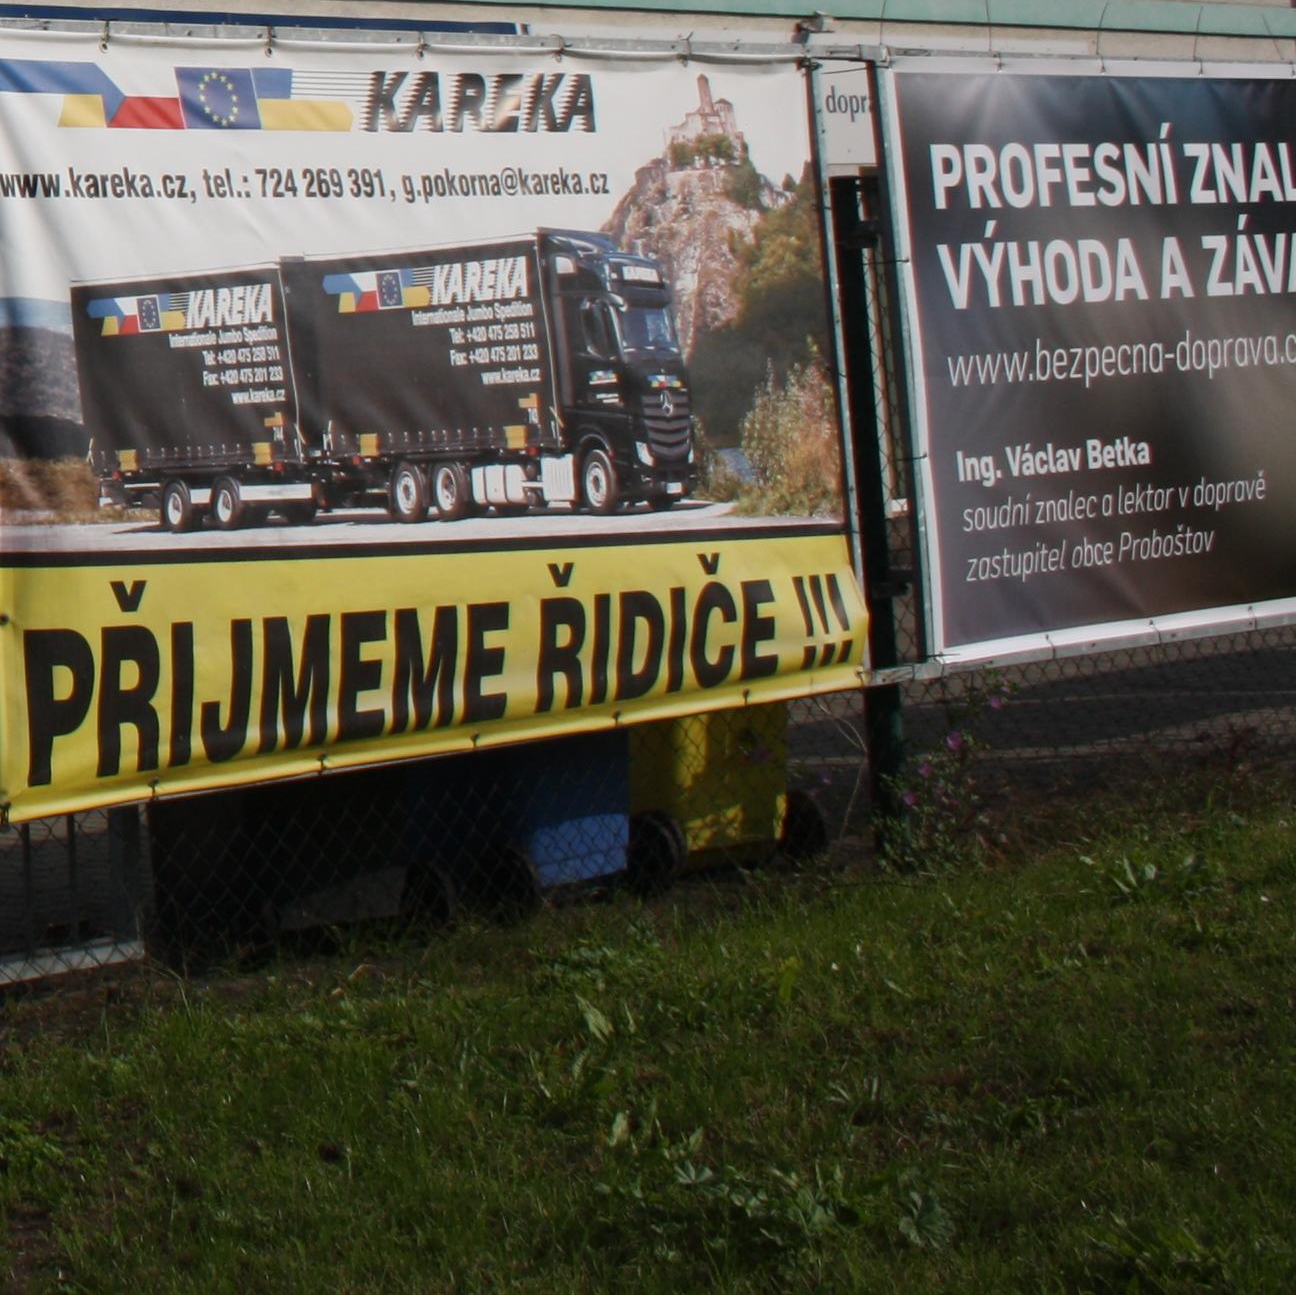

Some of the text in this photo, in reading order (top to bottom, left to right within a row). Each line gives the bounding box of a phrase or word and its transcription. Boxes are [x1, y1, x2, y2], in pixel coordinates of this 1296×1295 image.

[358, 70, 597, 133] KAREKA
[825, 85, 872, 123] dopr
[203, 169, 252, 199] tel.:
[255, 169, 298, 199] 724
[302, 168, 344, 198] 269
[347, 167, 397, 202] 391,
[401, 166, 610, 203] g.pokorna@kareka.cz
[929, 122, 1178, 210] PROFESNÍ
[431, 256, 528, 306] KAREKA
[936, 213, 1296, 310] VÝHODA A ZÁV
[187, 283, 273, 329] KAREKA
[488, 324, 503, 341] 475
[490, 346, 505, 363] 475
[956, 436, 1152, 488] Ing. Václav Betka
[962, 469, 1267, 533] soudní znalec a lektor v dopravě
[965, 523, 1216, 583] zastupitel obce Proboštov
[23, 553, 856, 788] PŘIJMEME ŘIDIČE !!!
